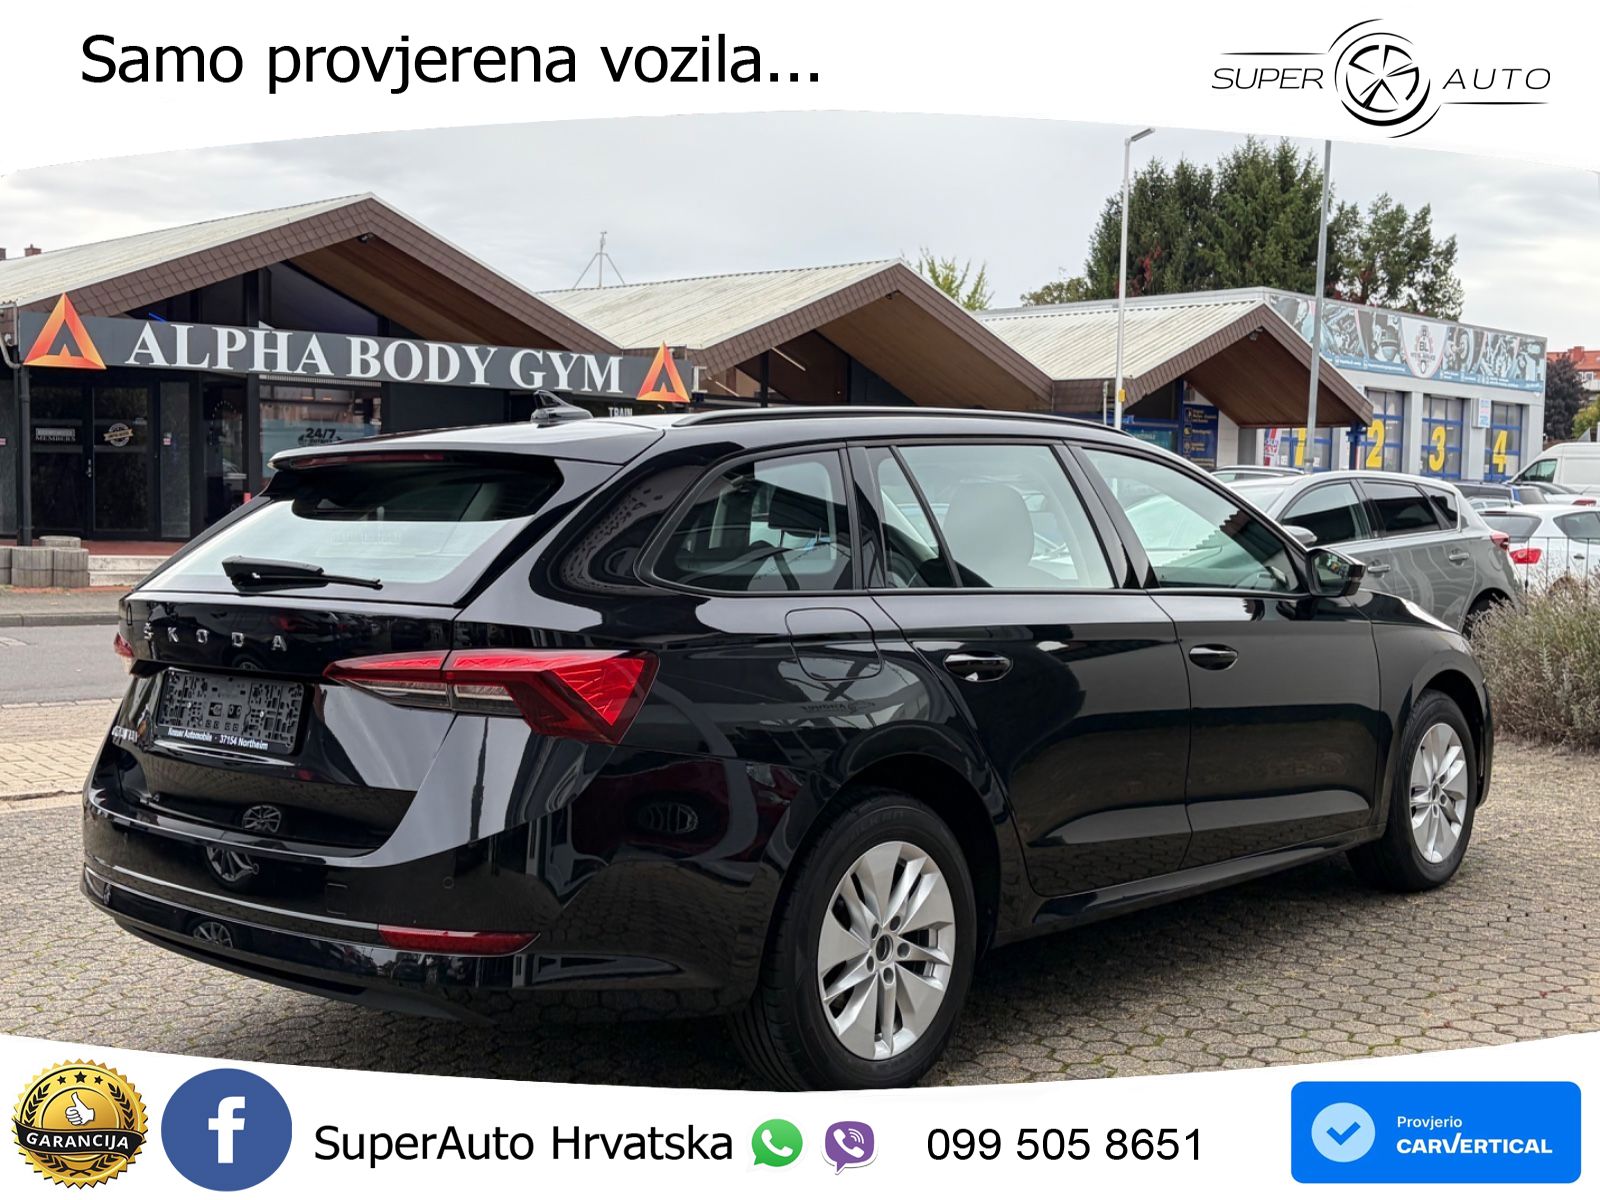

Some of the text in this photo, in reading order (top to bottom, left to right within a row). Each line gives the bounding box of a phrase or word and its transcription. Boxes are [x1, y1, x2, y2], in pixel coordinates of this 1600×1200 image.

[125, 321, 623, 394] ALPHA BODY GYM
[305, 427, 337, 440] 24/7
[1366, 419, 1385, 468] 2
[1429, 426, 1446, 472] 3
[1492, 430, 1508, 473] 4
[238, 737, 269, 751] Northeim
